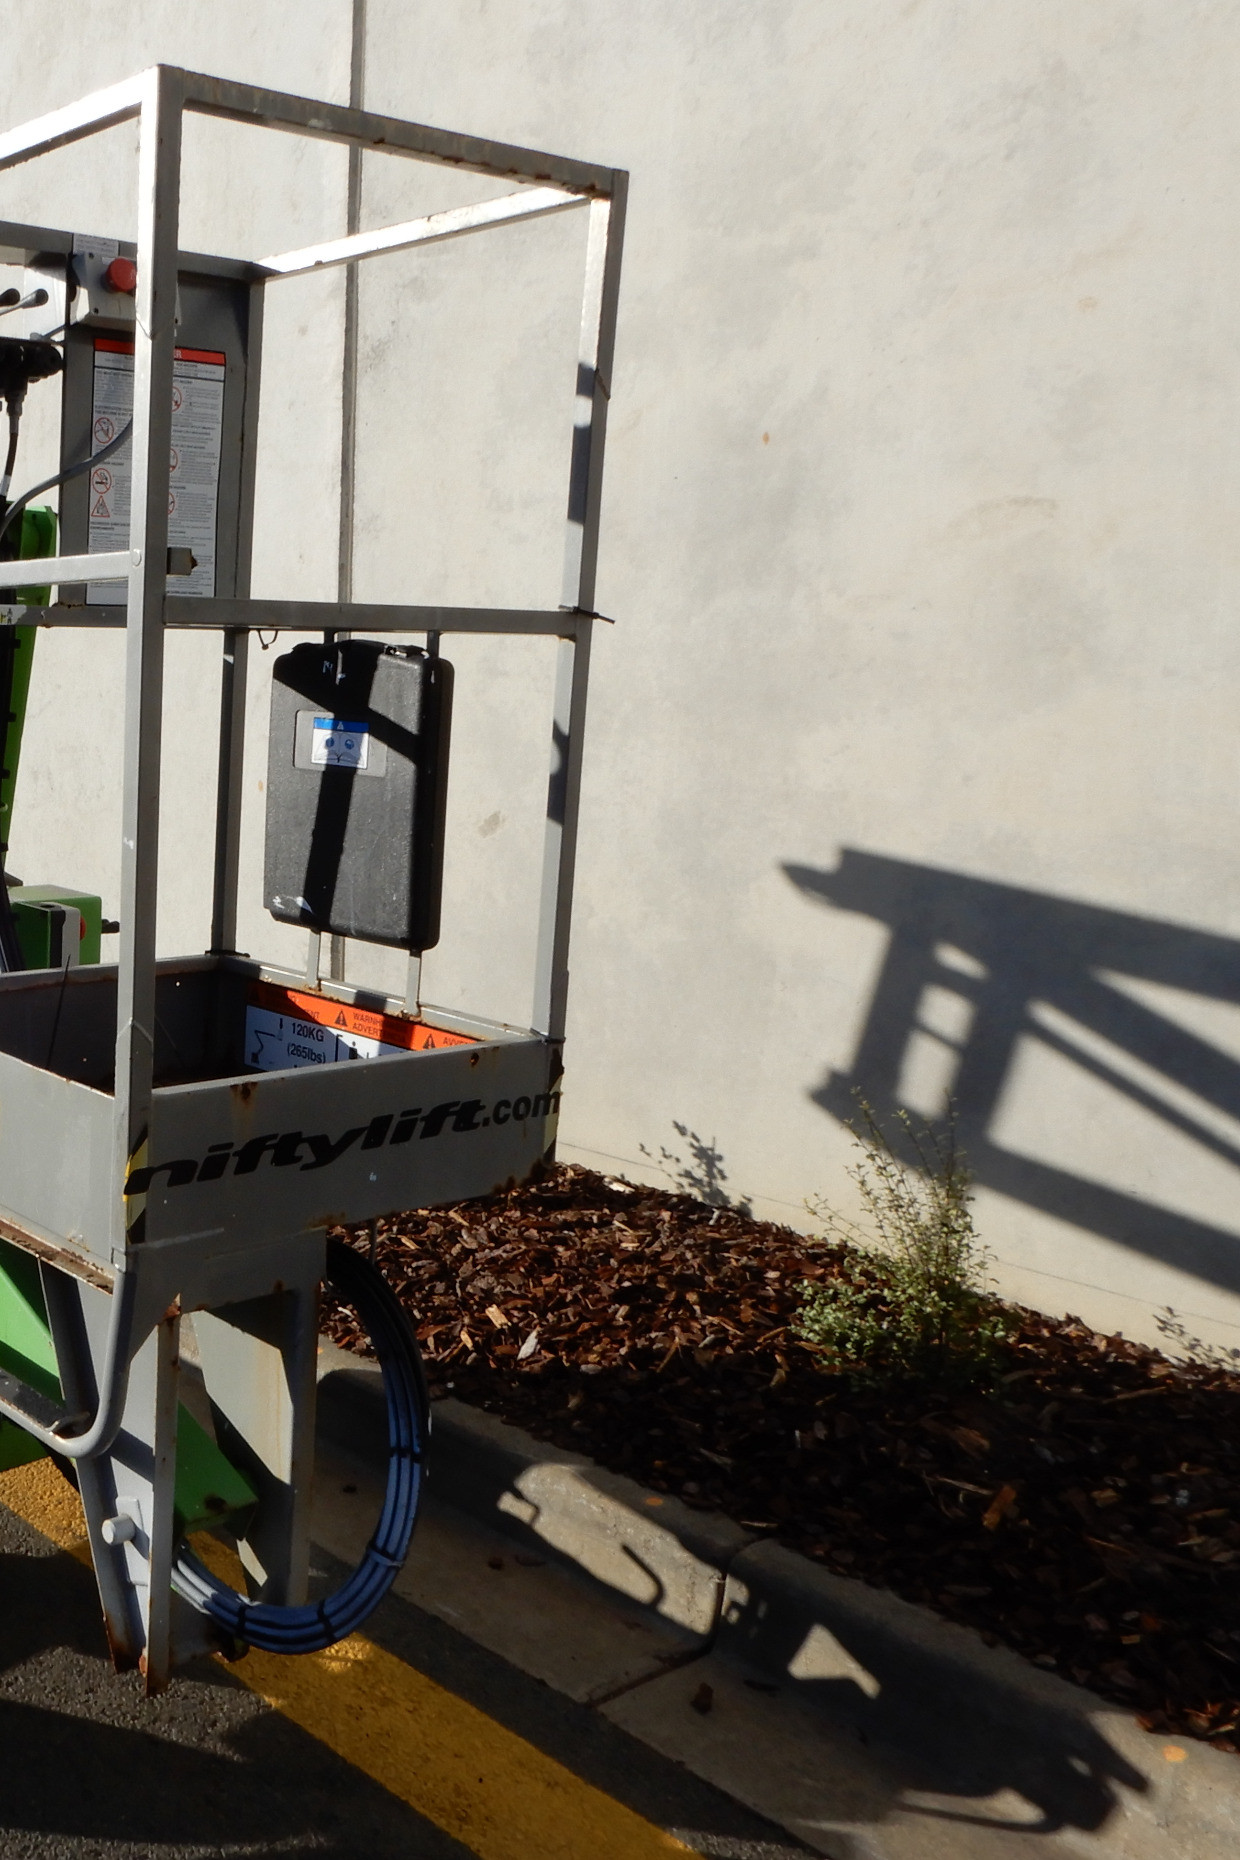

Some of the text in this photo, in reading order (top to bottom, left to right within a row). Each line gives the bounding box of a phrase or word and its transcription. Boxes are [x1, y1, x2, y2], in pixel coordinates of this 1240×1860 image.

[291, 1021, 324, 1043] 120KG
[287, 1043, 326, 1065] (265lbs)
[123, 1090, 561, 1196] niftylift.com
